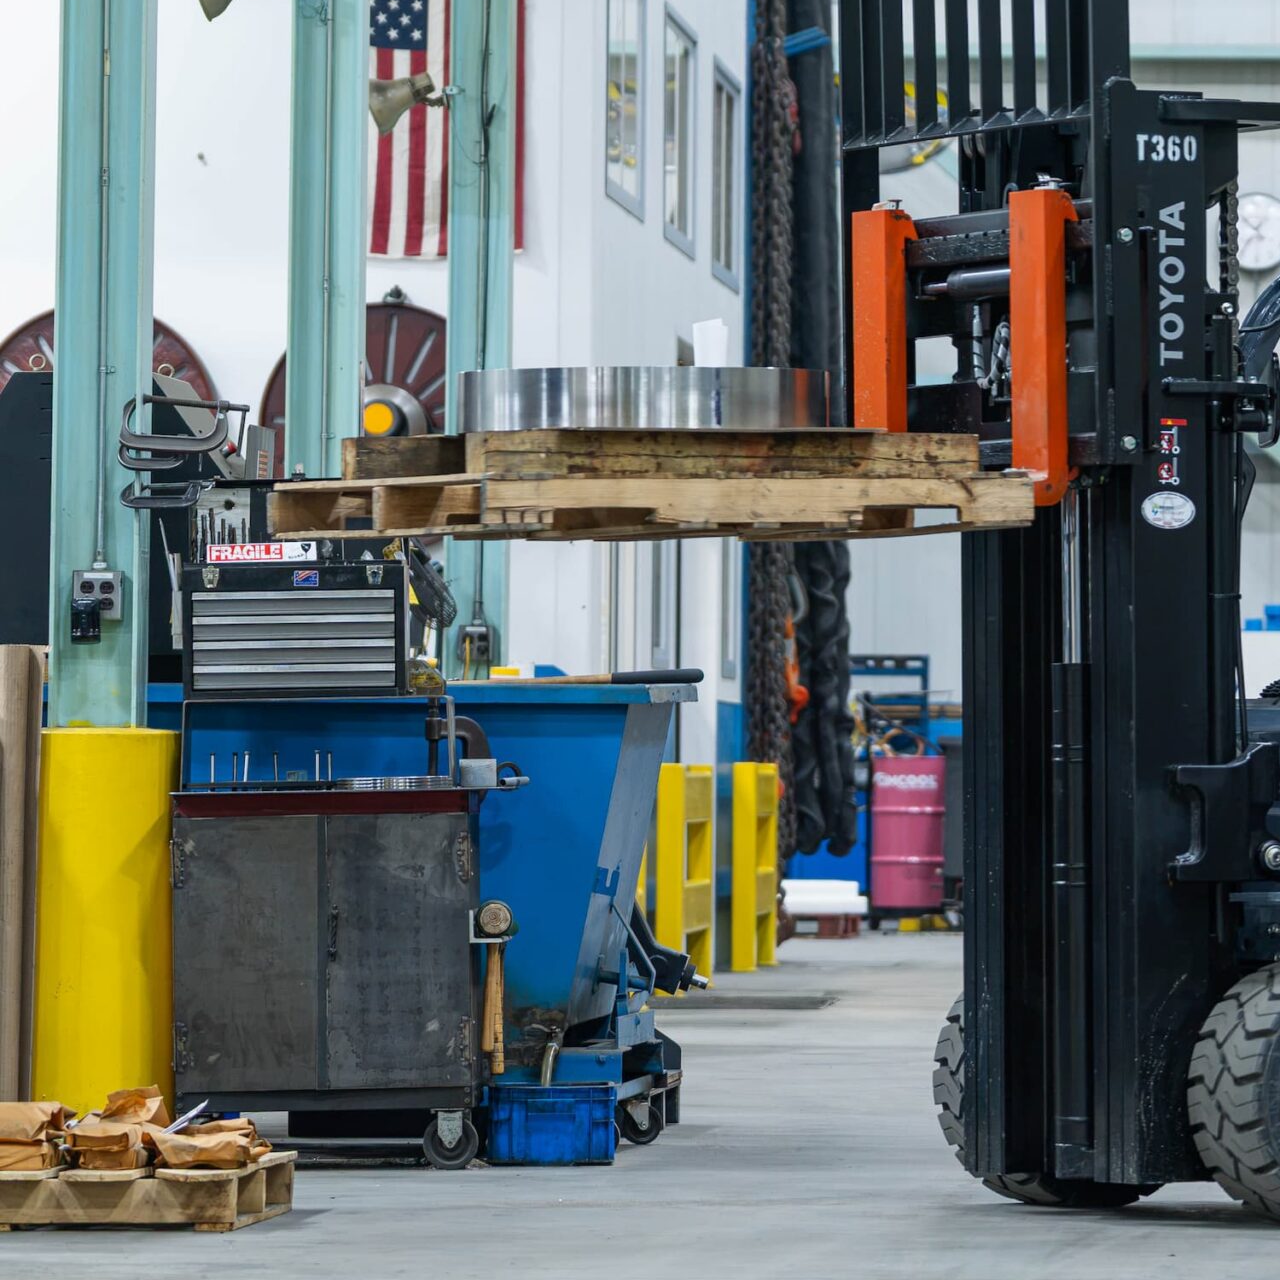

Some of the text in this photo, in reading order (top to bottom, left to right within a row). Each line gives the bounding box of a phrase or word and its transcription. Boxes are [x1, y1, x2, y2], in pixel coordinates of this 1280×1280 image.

[1135, 133, 1198, 162] T360
[1158, 200, 1186, 367] TOYOTA
[210, 543, 282, 561] FRAGILE
